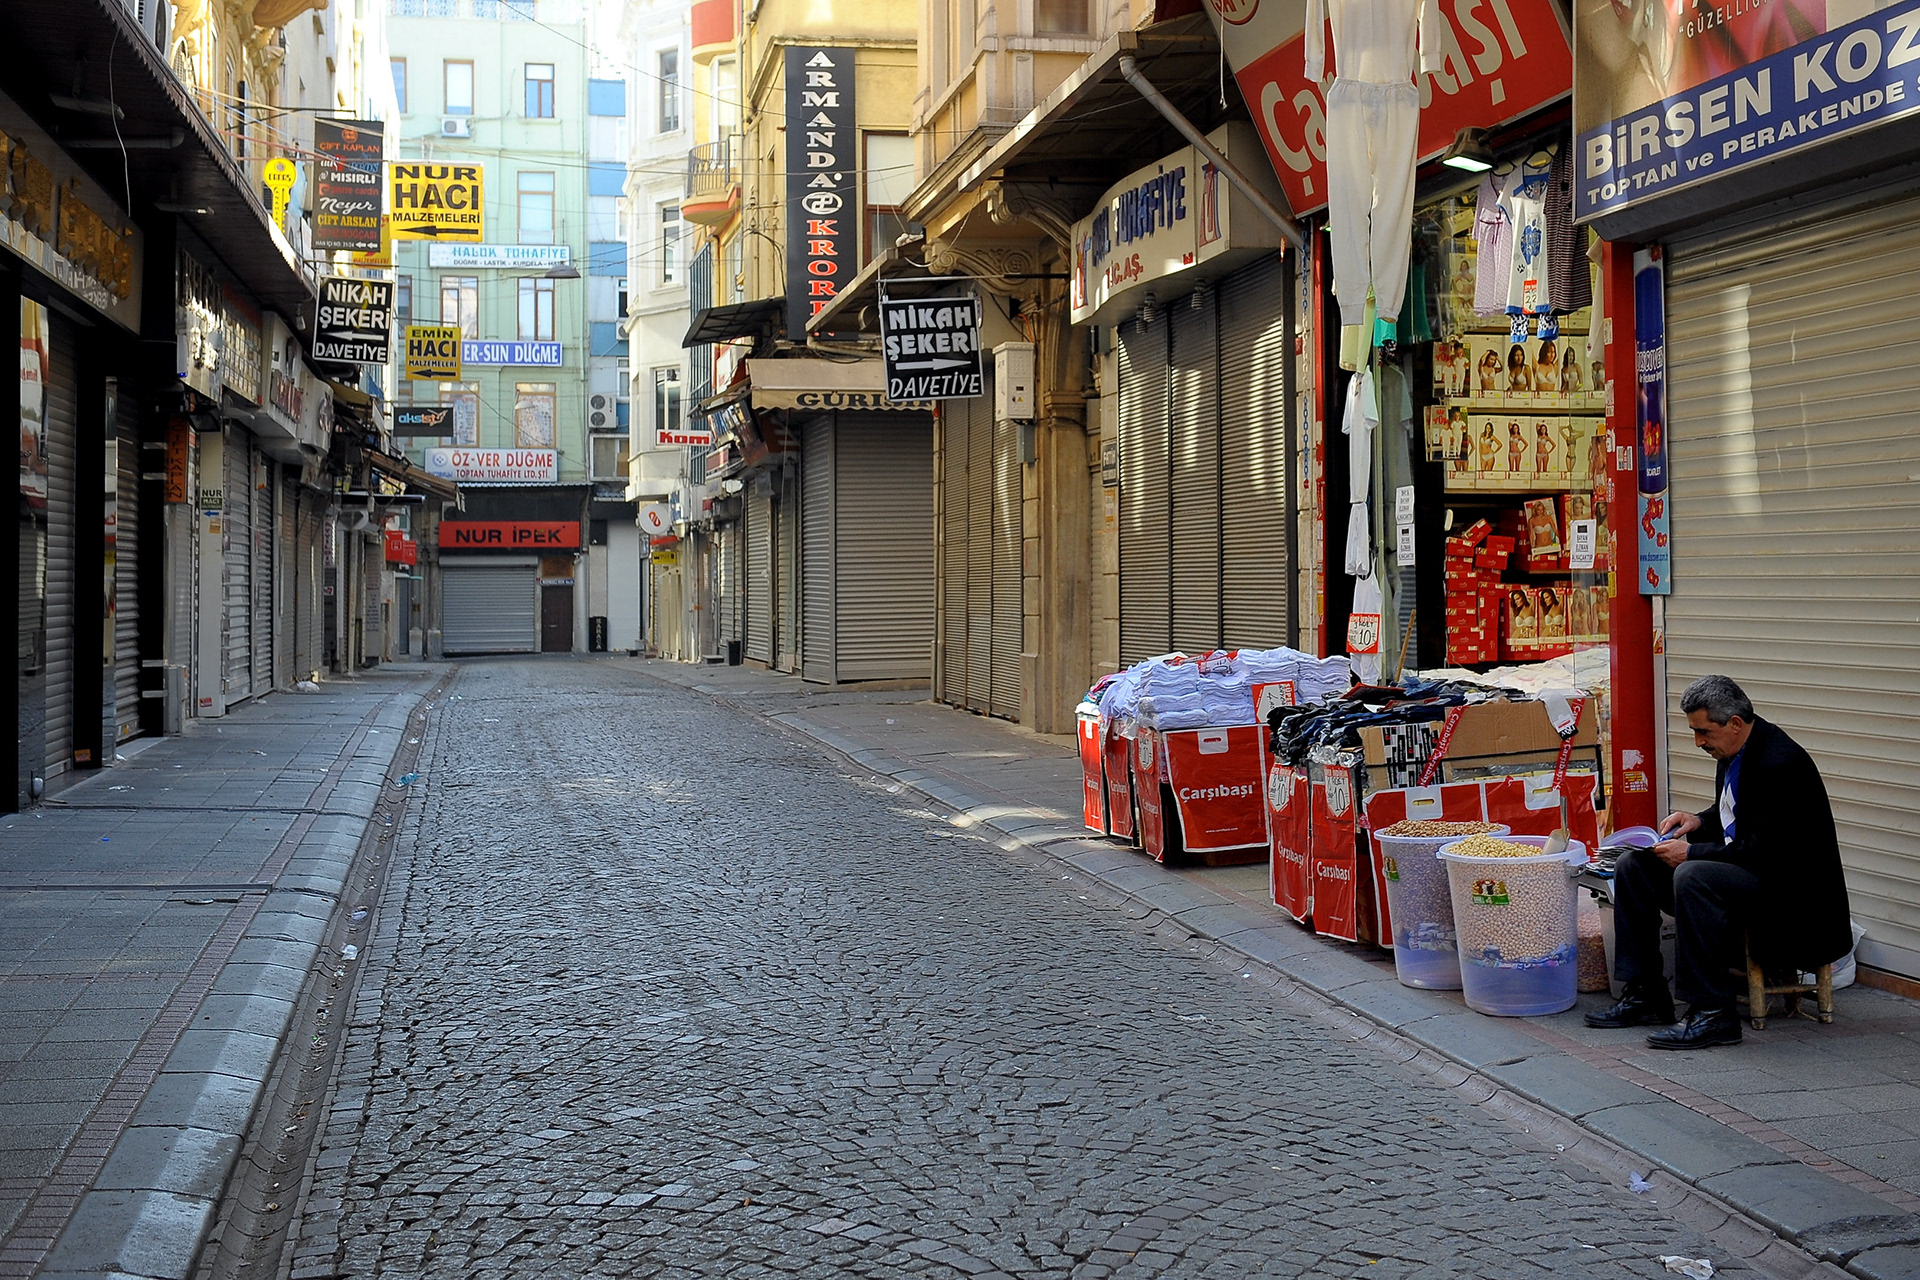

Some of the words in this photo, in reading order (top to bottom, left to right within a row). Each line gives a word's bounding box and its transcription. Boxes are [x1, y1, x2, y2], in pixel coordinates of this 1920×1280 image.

[802, 50, 840, 188] ARMANDA
[343, 142, 380, 153] KAPLAN
[1587, 160, 1677, 205] TOPTAN
[1686, 151, 1714, 172] ve
[1722, 80, 1905, 160] PERAKENDE
[395, 165, 477, 181] NUR
[395, 183, 479, 210] HACI
[1112, 164, 1187, 246] TUHAFİYE
[318, 212, 339, 227] ÇİFT
[341, 216, 377, 228] ARSLAN
[393, 212, 481, 224] MALZEMELERİ
[505, 246, 567, 258] TUHAFİYE
[327, 281, 387, 305] NİKAH
[319, 306, 391, 329] ŞEKERİ
[889, 304, 972, 330] NİKAH
[412, 328, 453, 338] EMİN
[315, 342, 387, 361] DAVETİYE
[408, 340, 456, 357] HACI
[463, 345, 509, 362] ER-SUN
[514, 343, 559, 363] DÜĞME
[886, 327, 978, 361] ŞEKERİ
[408, 359, 457, 368] MALZEMELERİ
[890, 371, 980, 398] DAVETİYE
[506, 451, 553, 468] DÜĞME
[456, 469, 484, 478] TOPTAN
[488, 468, 521, 478] TUHAFİYE
[201, 489, 222, 497] NUR
[456, 529, 502, 544] NUR
[512, 526, 562, 544] İPEK
[1358, 629, 1372, 645] 10
[1180, 784, 1253, 803] Çarşıbaşı
[1276, 782, 1287, 808] 10
[1334, 787, 1346, 812] 10
[1316, 861, 1352, 884] Çarşıbaşı
